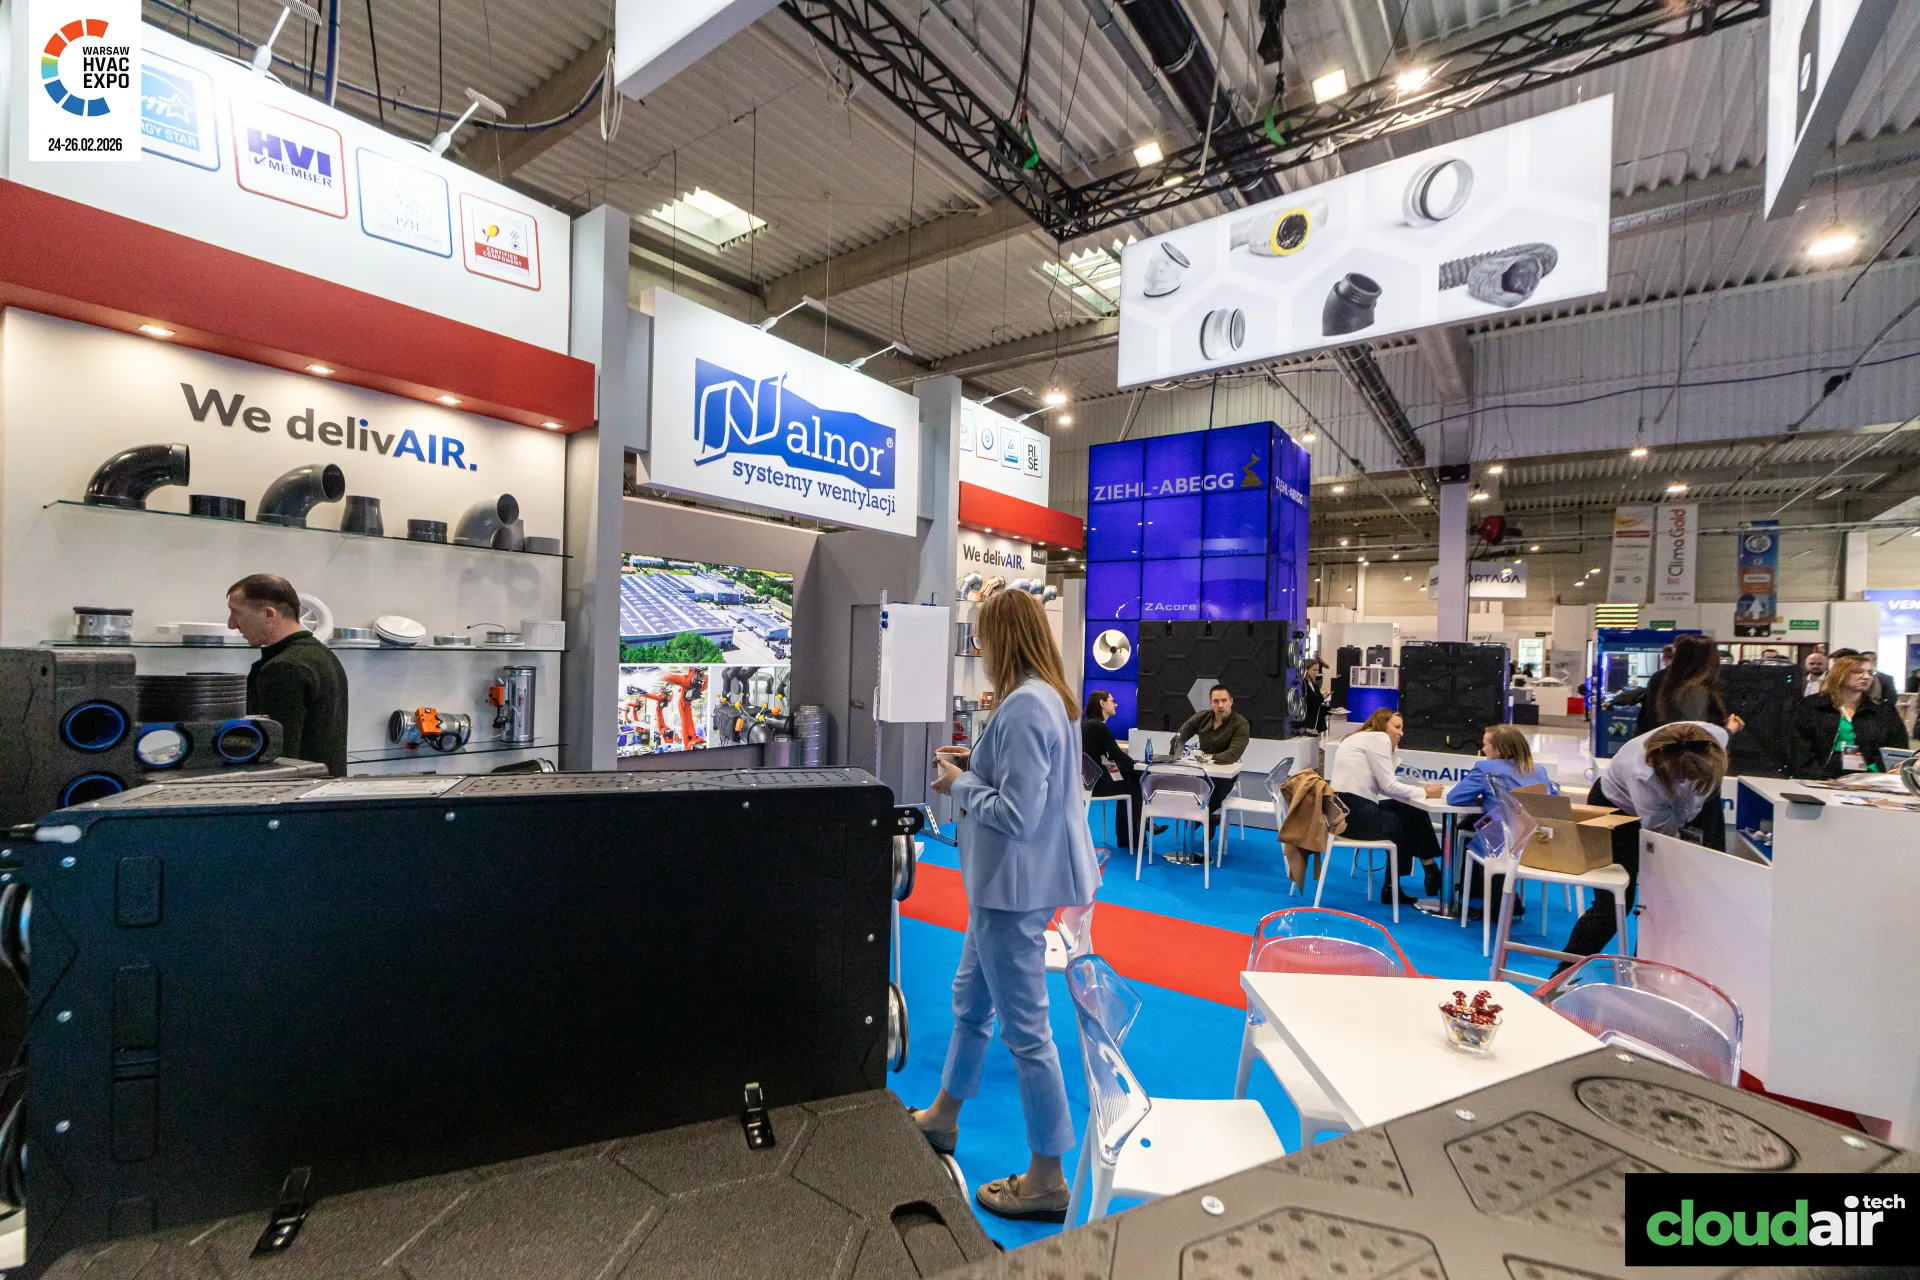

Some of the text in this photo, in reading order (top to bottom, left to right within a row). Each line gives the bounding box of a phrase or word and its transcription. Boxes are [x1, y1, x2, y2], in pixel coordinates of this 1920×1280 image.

[164, 128, 198, 148] STAR
[246, 126, 333, 178] HVI
[268, 160, 333, 188] MEMBER
[180, 382, 478, 472] We delivAIR.
[732, 460, 896, 516] systemy wentylacji
[1094, 472, 1235, 501] ZIEHL-ABEGG
[962, 543, 1025, 571] We delivAIR.
[1144, 602, 1197, 611] ZAcore
